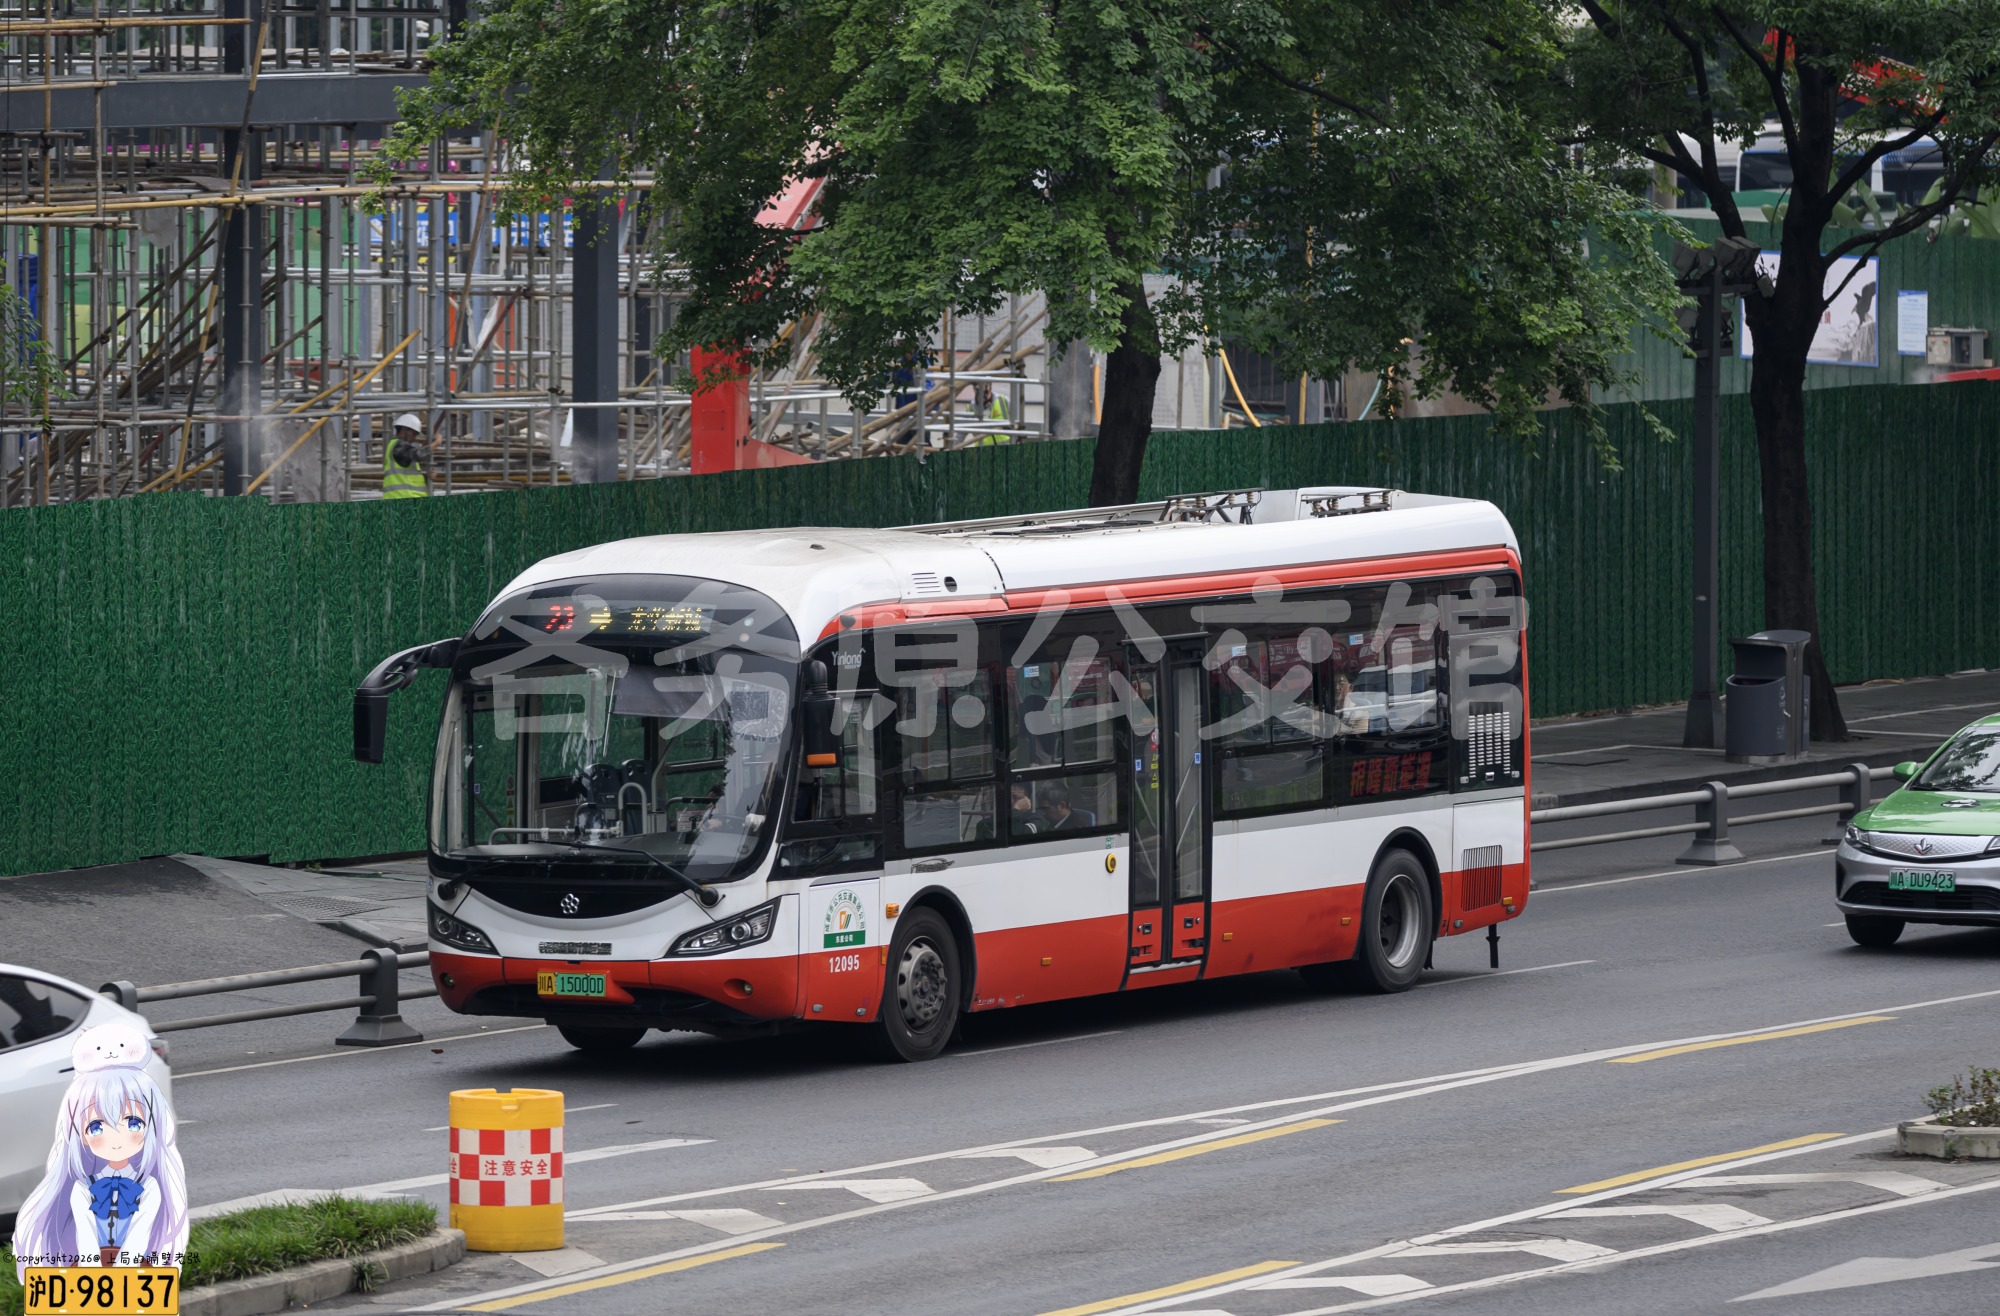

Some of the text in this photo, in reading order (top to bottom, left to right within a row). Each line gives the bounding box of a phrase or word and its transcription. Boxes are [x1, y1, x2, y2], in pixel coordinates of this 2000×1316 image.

[831, 650, 863, 668] Yinlong
[828, 954, 860, 974] 12095
[484, 1158, 548, 1177] 注意安全
